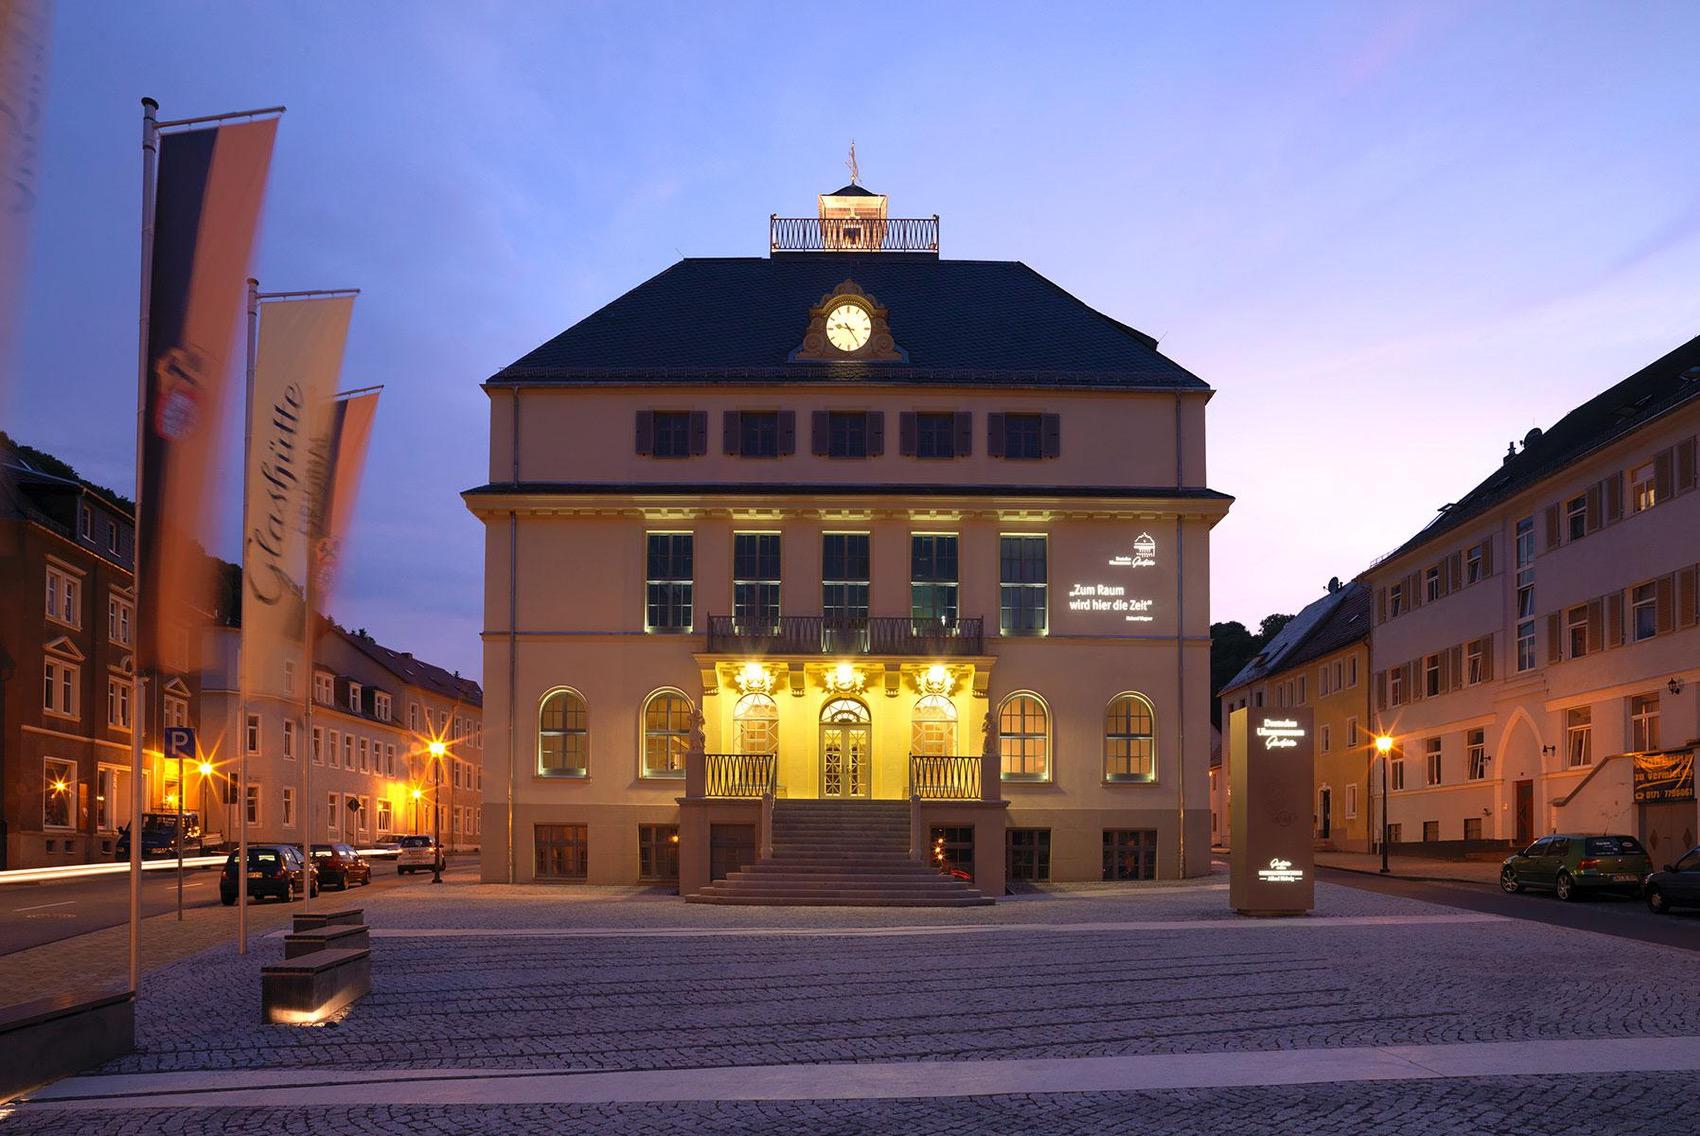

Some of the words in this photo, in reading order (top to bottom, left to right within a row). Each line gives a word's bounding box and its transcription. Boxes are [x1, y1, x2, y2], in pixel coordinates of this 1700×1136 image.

[1097, 584, 1124, 596] Raum
[1069, 599, 1090, 610] wird
[1092, 599, 1112, 610] hier
[1112, 599, 1128, 611] die
[171, 731, 189, 755] P
